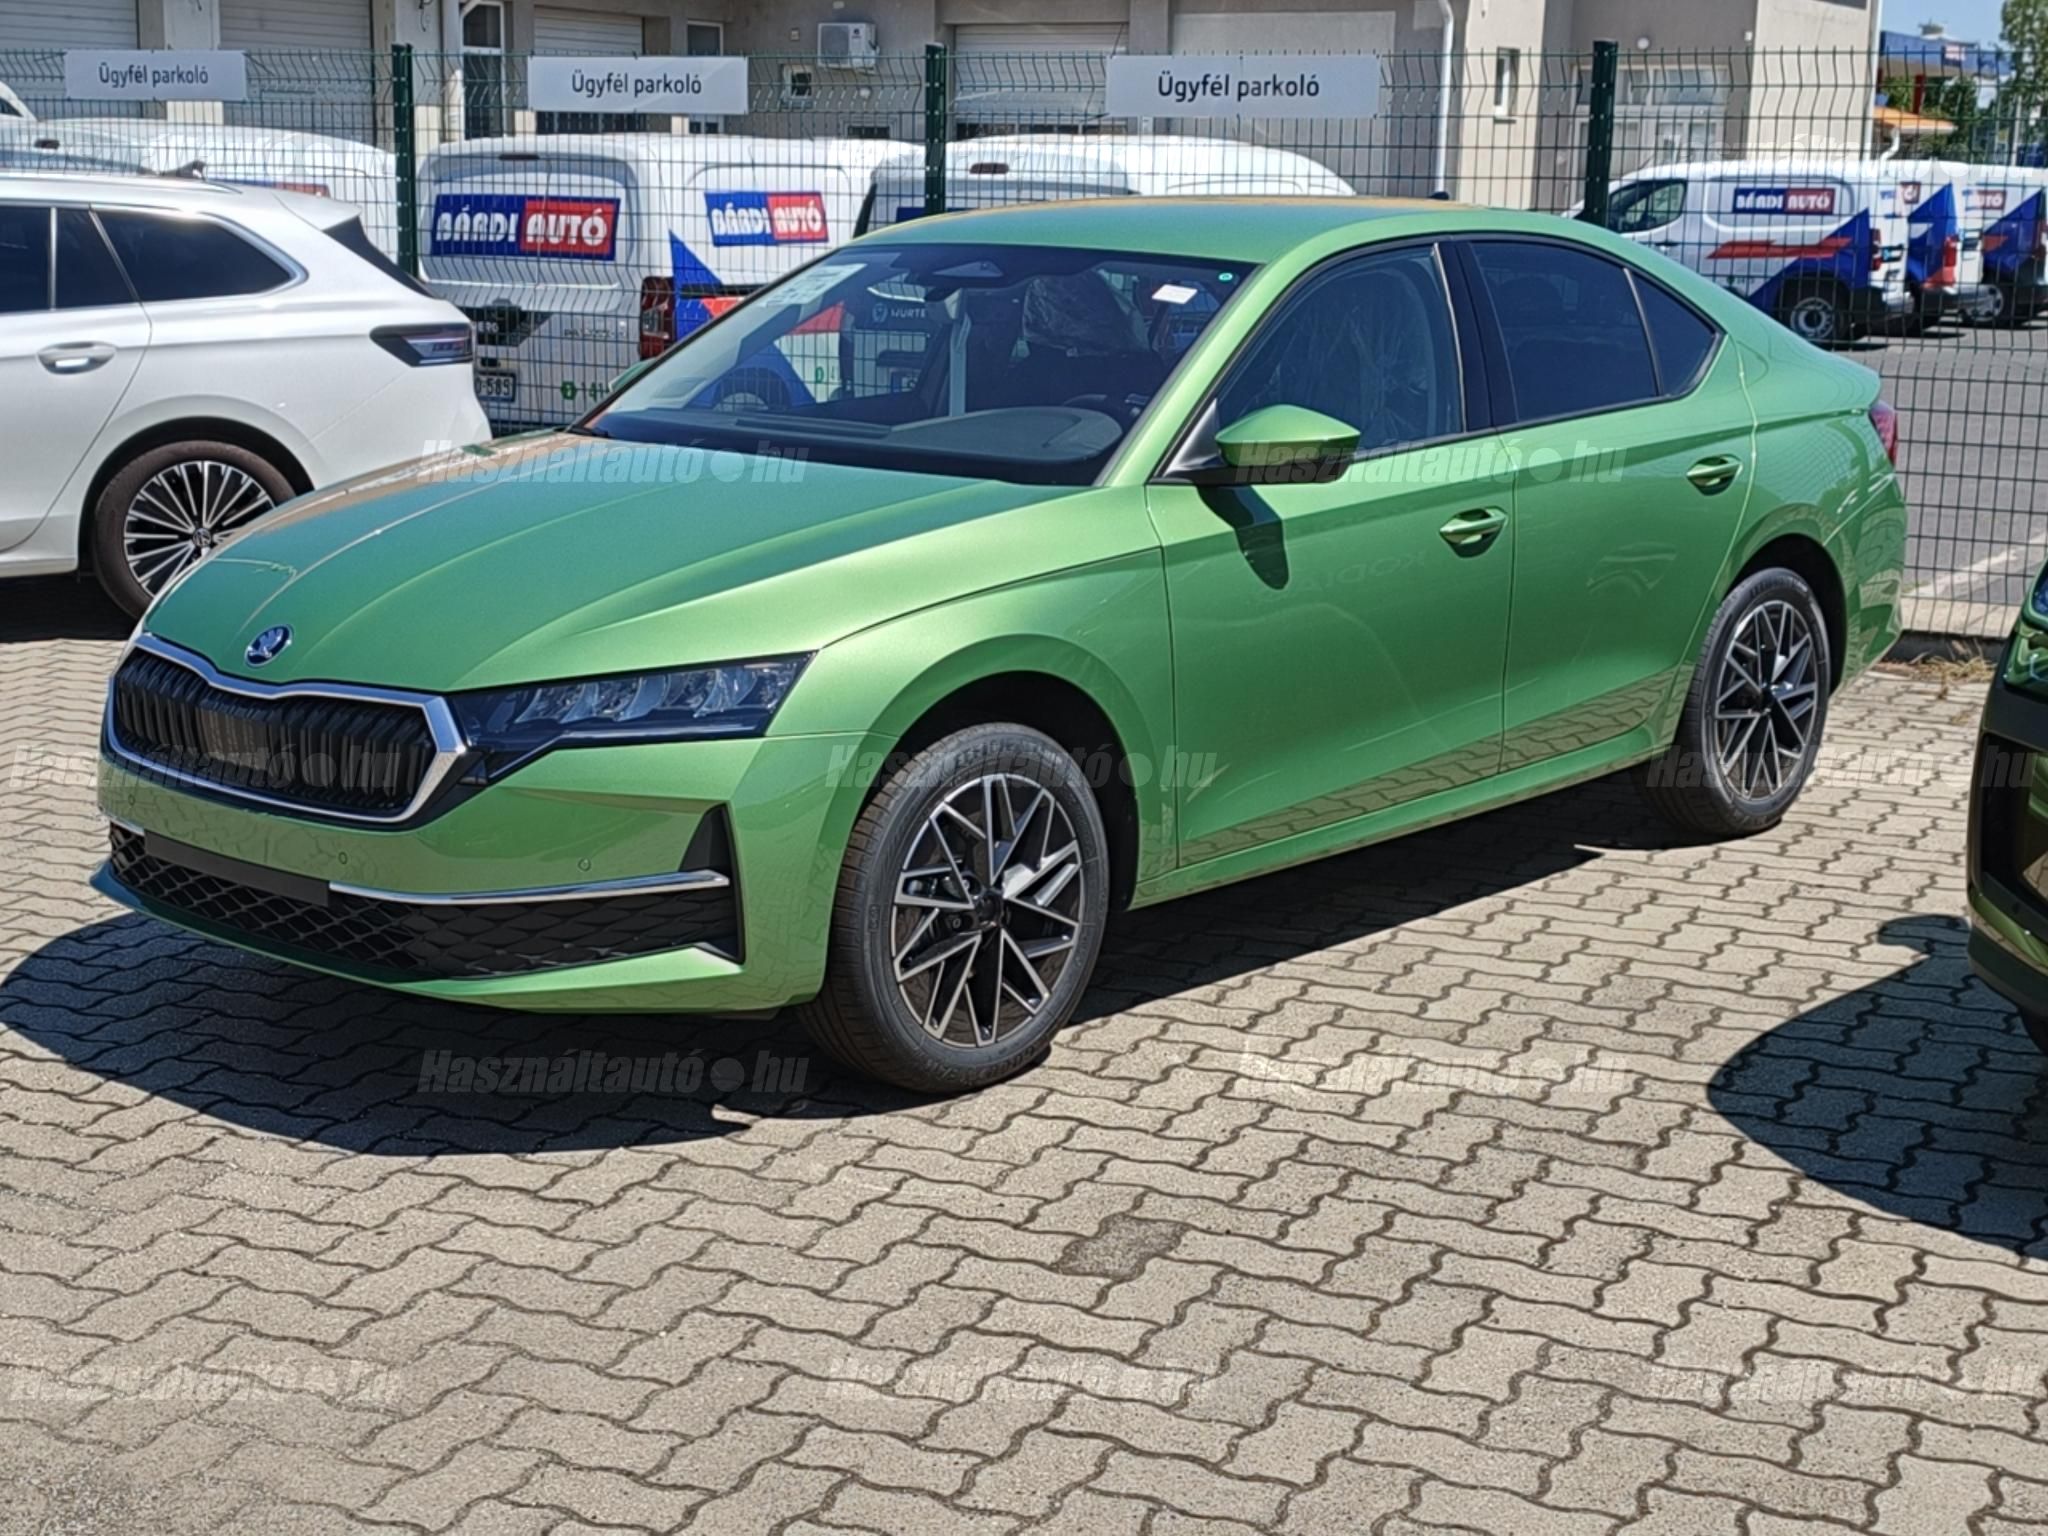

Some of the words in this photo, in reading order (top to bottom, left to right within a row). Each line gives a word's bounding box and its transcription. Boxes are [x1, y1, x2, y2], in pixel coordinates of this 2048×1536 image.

[99, 62, 148, 89] Ügyfél
[152, 64, 209, 88] parkoló
[571, 69, 629, 98] Ügyfél
[634, 73, 702, 98] parkoló
[1158, 70, 1230, 102] Ügyfél
[1237, 73, 1320, 102] parkoló
[435, 204, 519, 243] BÁRDI
[525, 208, 608, 247] AUTÓ
[773, 200, 823, 234] AUTÓ
